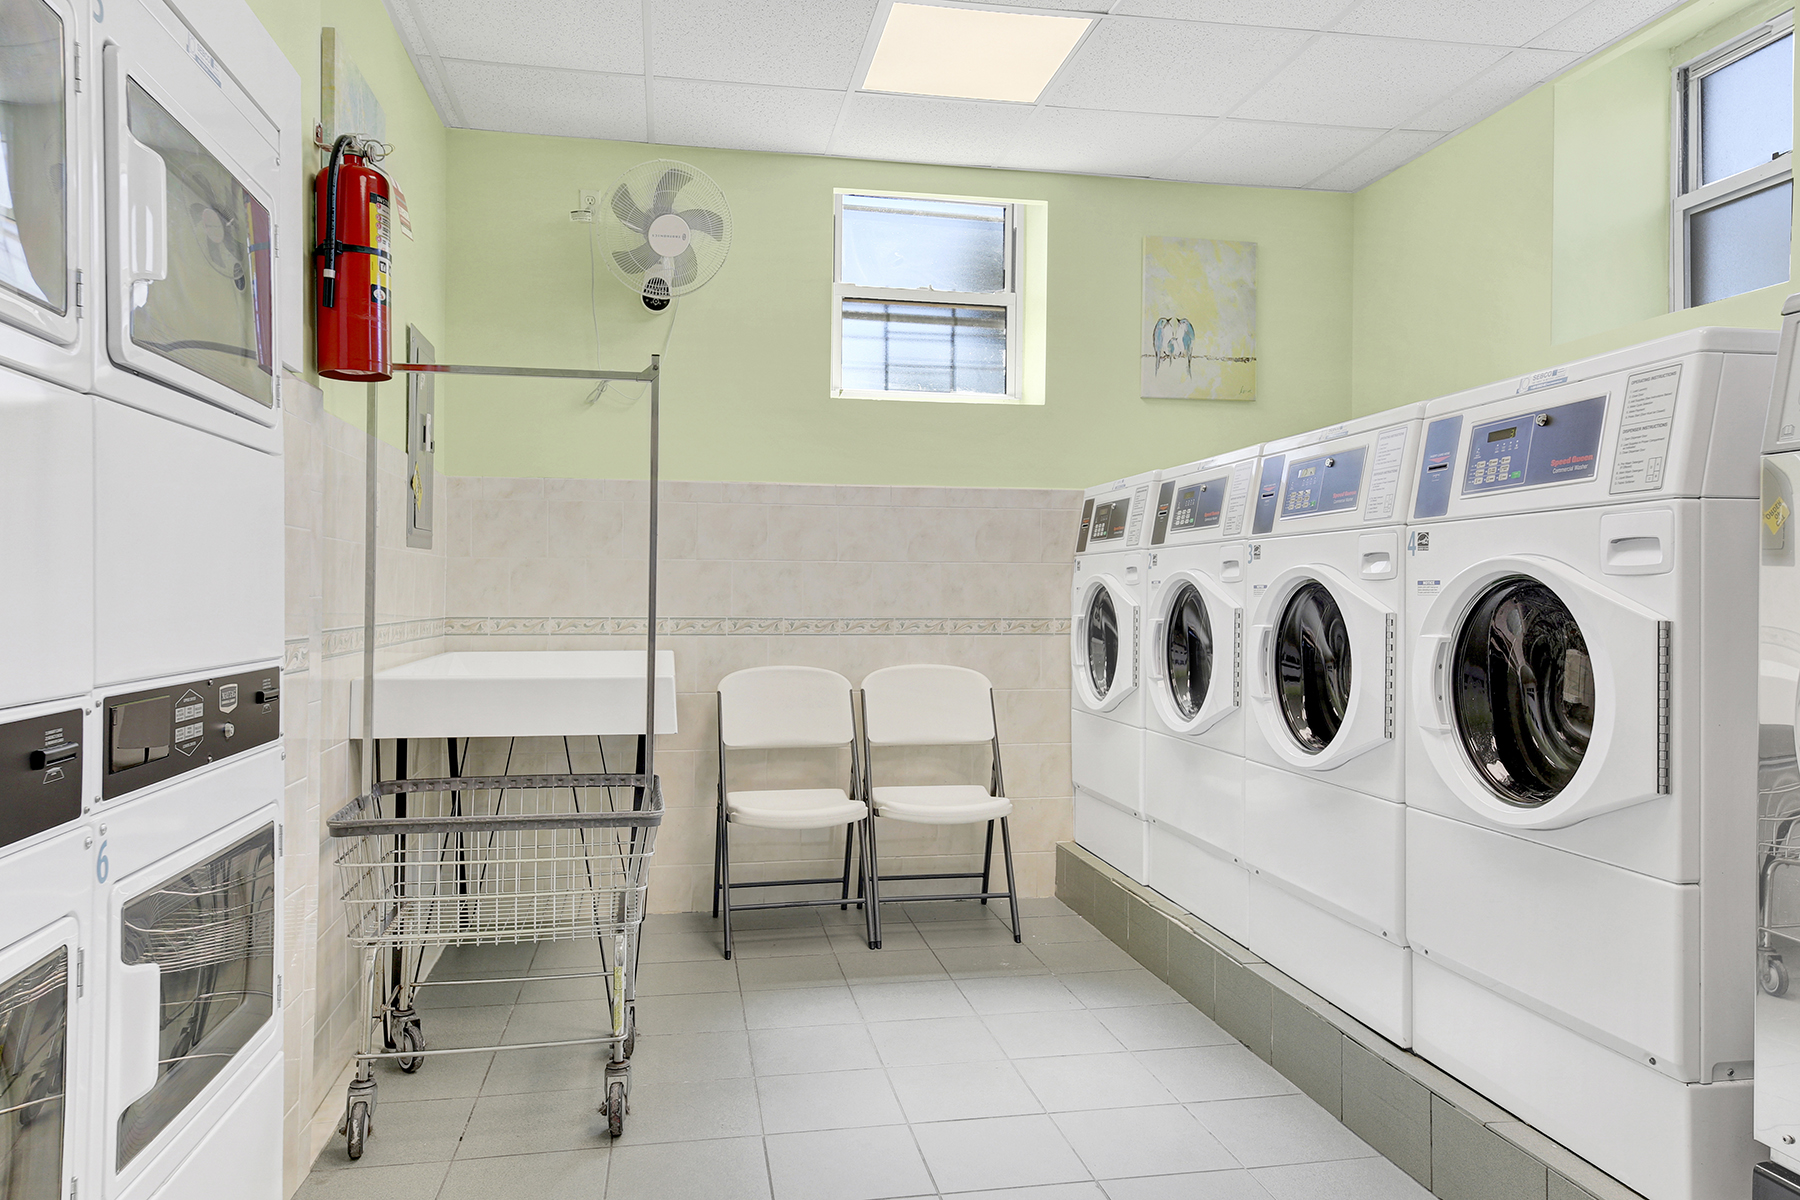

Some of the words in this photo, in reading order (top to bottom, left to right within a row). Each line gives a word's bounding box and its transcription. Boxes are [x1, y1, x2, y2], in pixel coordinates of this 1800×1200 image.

[1550, 456, 1572, 467] Speed
[1572, 454, 1594, 463] Queen
[1552, 466, 1573, 474] Commercial
[1408, 531, 1416, 556] 4
[1248, 544, 1253, 564] 3
[97, 840, 109, 884] 6
